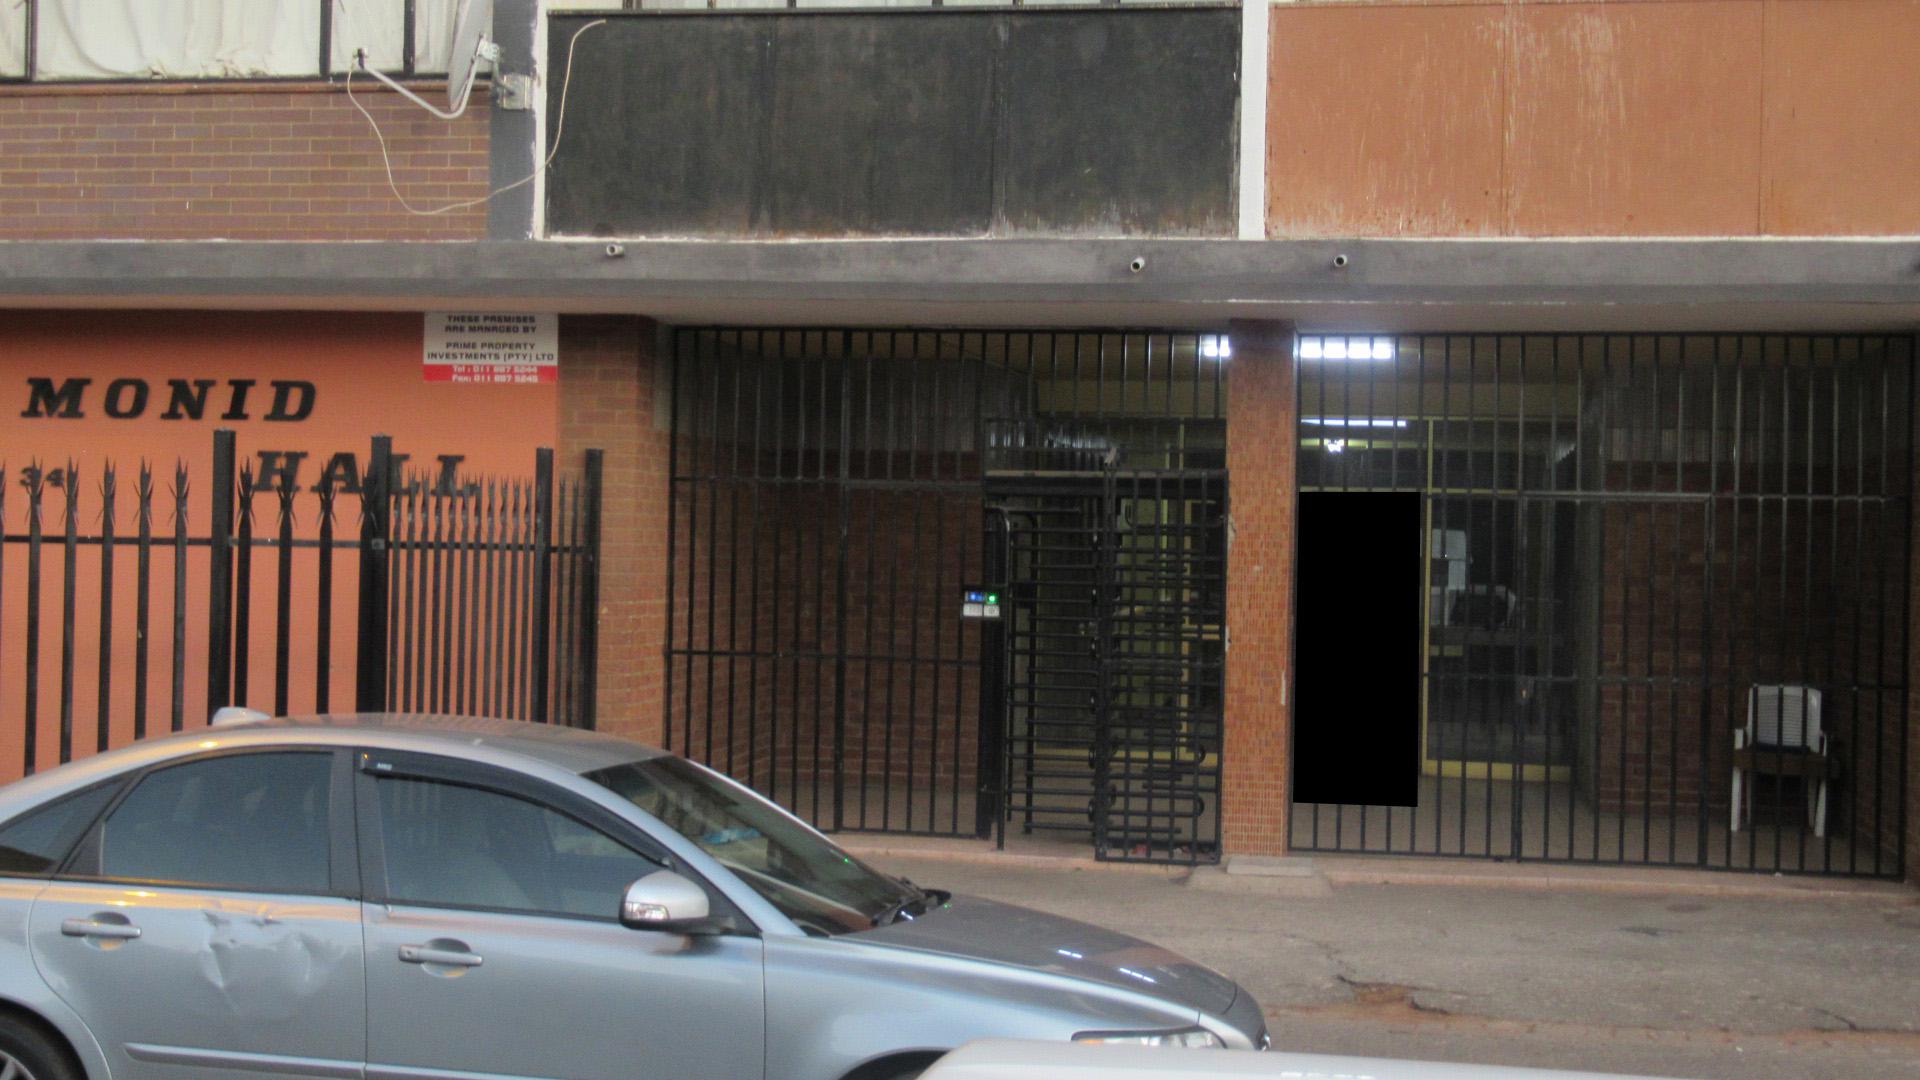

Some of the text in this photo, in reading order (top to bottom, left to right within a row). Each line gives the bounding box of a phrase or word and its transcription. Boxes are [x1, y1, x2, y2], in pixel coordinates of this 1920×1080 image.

[448, 315, 536, 323] THESE PREMISES
[445, 325, 537, 333] ARE MANAGED BY
[446, 342, 536, 350] PRIME PROPERTY
[427, 352, 554, 362] INVESTMENTS (PTY) LTD
[20, 377, 316, 423] MONID
[20, 466, 65, 487] 34
[252, 451, 481, 496] HALL
